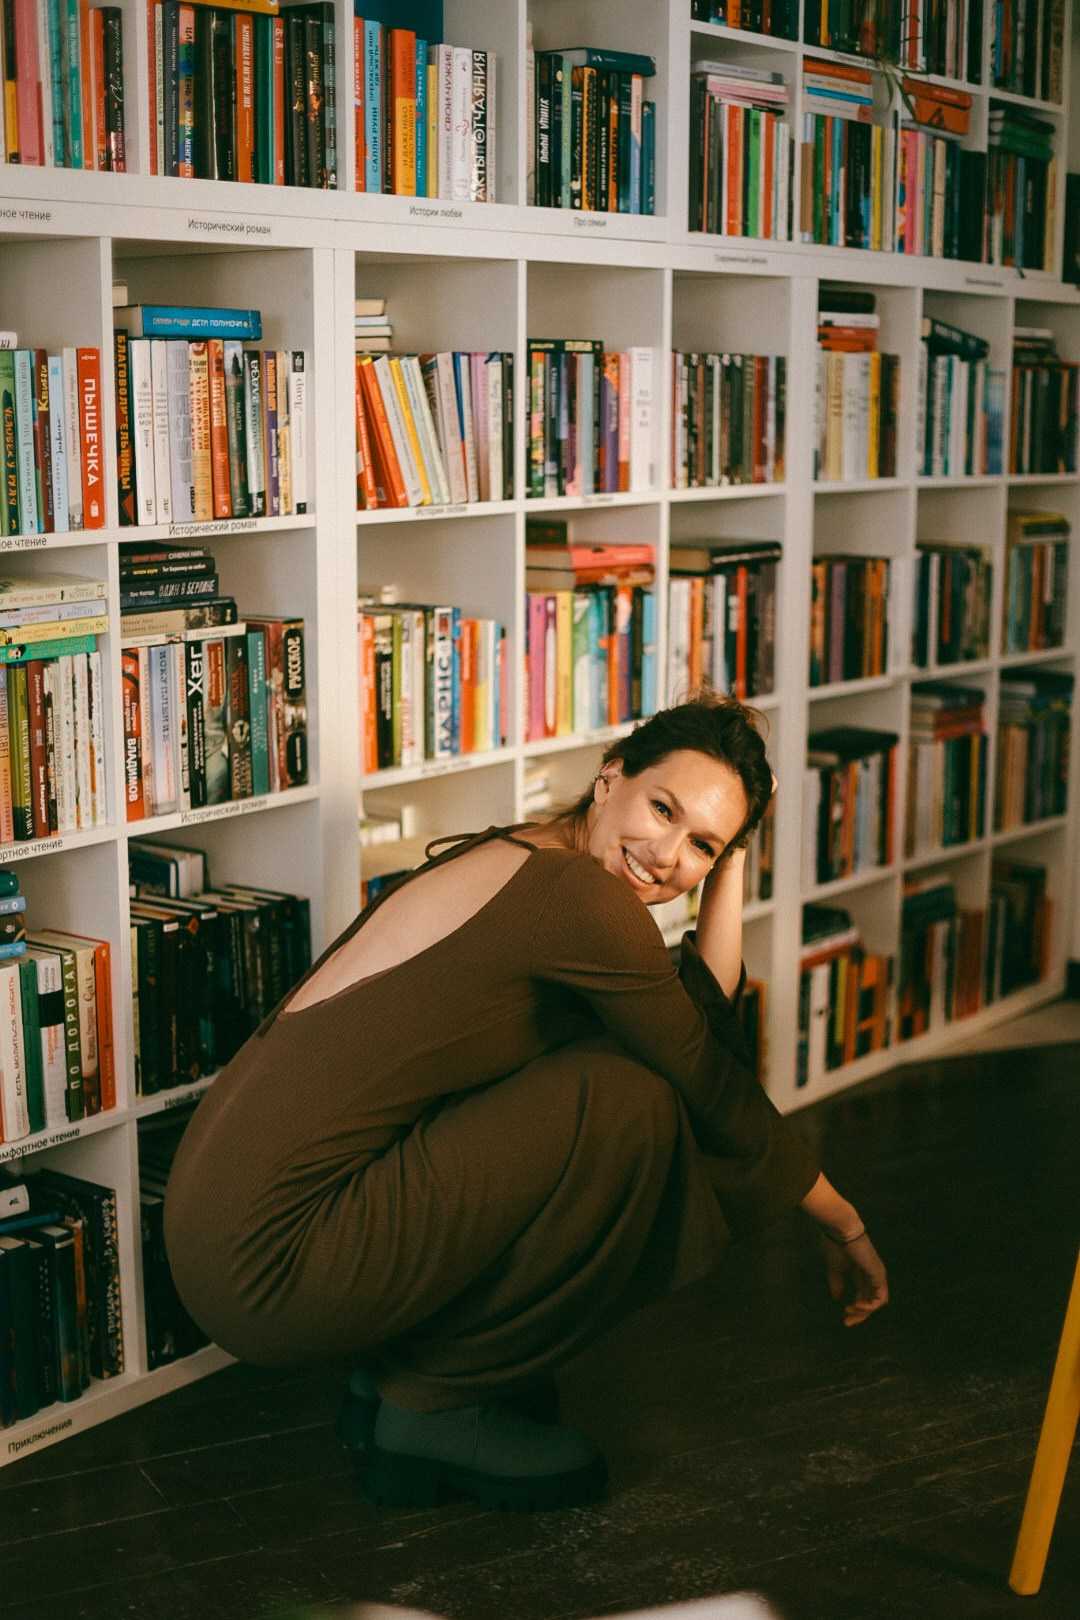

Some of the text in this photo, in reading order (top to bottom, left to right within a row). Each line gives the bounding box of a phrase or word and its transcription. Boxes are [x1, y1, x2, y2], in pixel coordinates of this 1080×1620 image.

[473, 52, 486, 200] АКТЫ ОТЧАЯНИЯ
[184, 138, 193, 178] МЕНГИСТЕ
[18, 209, 51, 221] чтение
[188, 219, 271, 235] Исторический роман
[409, 205, 463, 219] Истории любви
[192, 318, 208, 327] ДЕТИ
[210, 319, 243, 328] ПОЛУНОЧИ
[37, 364, 49, 412] Квинни
[294, 378, 304, 412] Лавр
[84, 378, 99, 486] ПЫШЕЧКА
[116, 335, 130, 490] БЛАГОВОЛИТЕЛЬНИЦЫ
[24, 451, 32, 493] Таунсенд
[0, 536, 47, 549] ое чтение
[168, 520, 257, 536] Исторический роман
[158, 583, 180, 598] ОДИН
[180, 582, 186, 595] В
[186, 579, 216, 595] БЕРЛИНЕ
[287, 636, 302, 689] РУССКОЕ
[159, 650, 170, 742] ИСКУПЛЕНИЕ
[438, 656, 452, 752] БАРНС
[20, 719, 33, 835] ИСТОРИЯ АРТУРА ТРУЛАВА
[126, 738, 139, 802] ВЛАДИМОВ
[180, 799, 267, 823] Исторический роман
[31, 838, 63, 853] чтение
[8, 976, 16, 1015] ЛЮБИТЬ
[64, 953, 81, 1090] ПО ДОРОГАМ
[49, 1128, 80, 1143] чтение
[7, 1418, 72, 1454] Приключения
